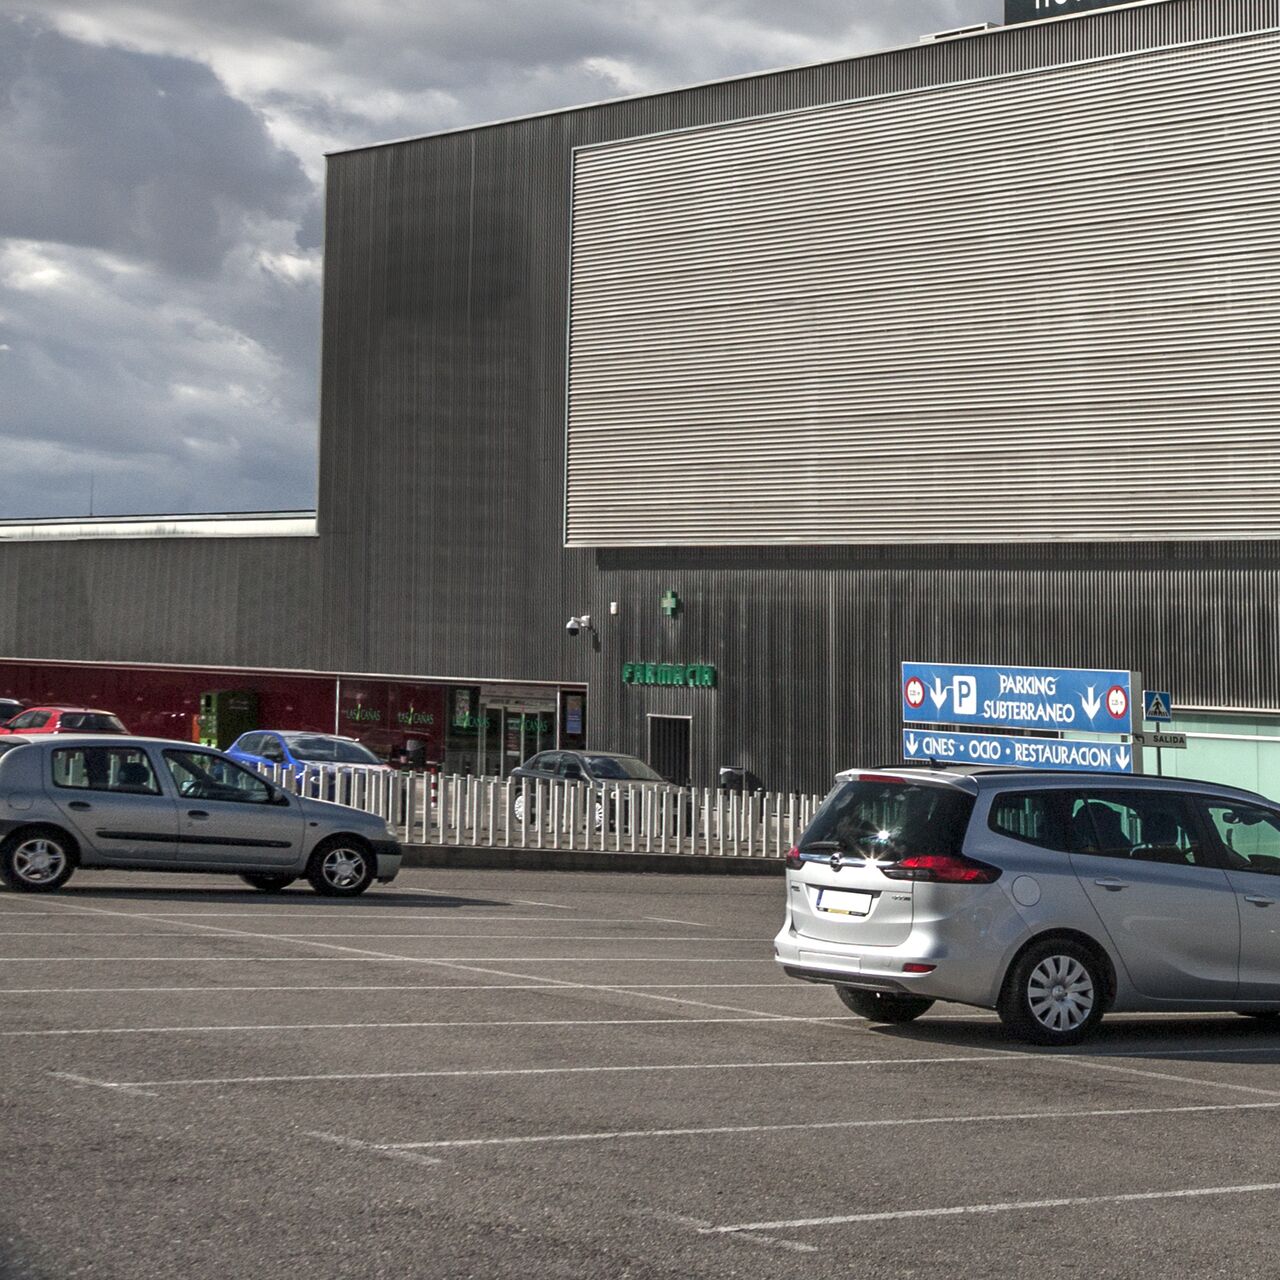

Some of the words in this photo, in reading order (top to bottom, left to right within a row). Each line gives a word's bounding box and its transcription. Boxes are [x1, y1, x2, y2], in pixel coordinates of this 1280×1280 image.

[1000, 674, 1057, 696] PARKING
[983, 700, 1075, 723] SUBTERRANEO
[1153, 734, 1185, 745] SALIDA
[922, 737, 955, 756] CINES
[969, 740, 1001, 758] OCIO
[1015, 744, 1111, 767] RESTAURACION
